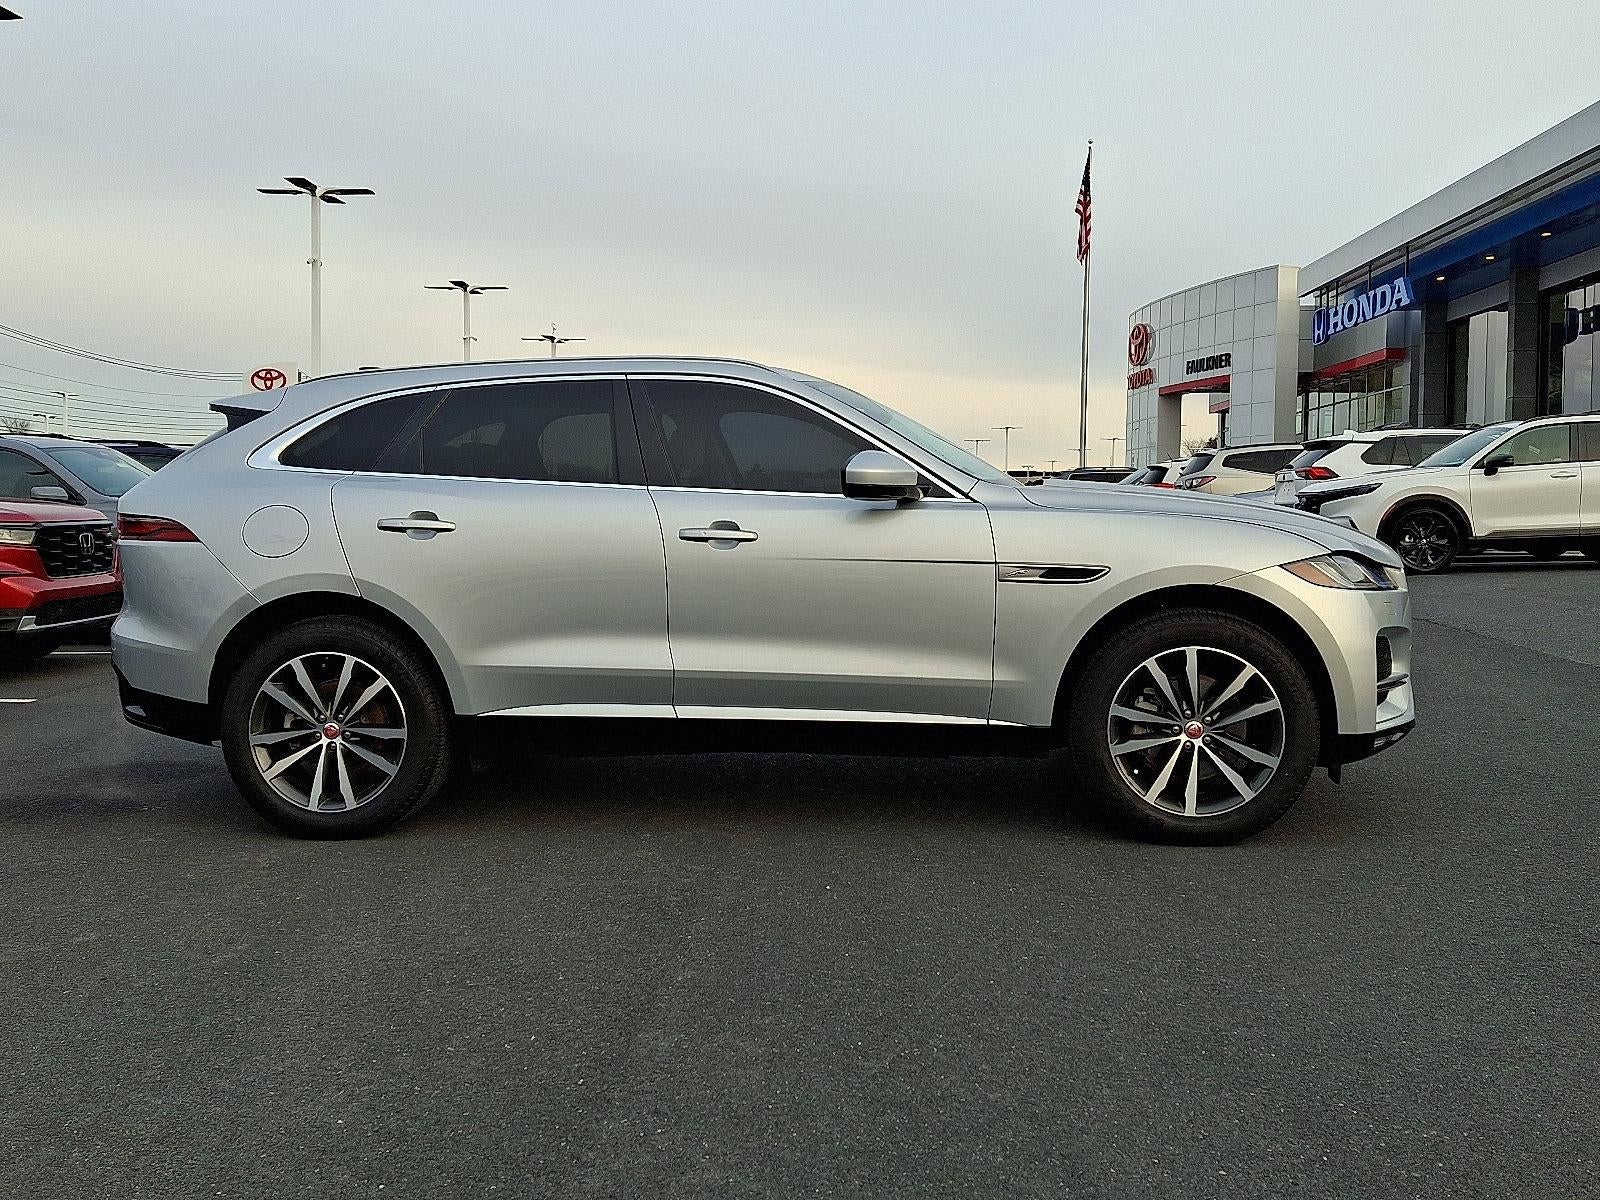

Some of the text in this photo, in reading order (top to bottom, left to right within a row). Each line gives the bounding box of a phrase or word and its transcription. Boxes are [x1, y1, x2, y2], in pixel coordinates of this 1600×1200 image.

[1328, 277, 1411, 335] HONDA
[1186, 353, 1231, 375] FAULKNER
[1127, 368, 1154, 390] TOYOTA
